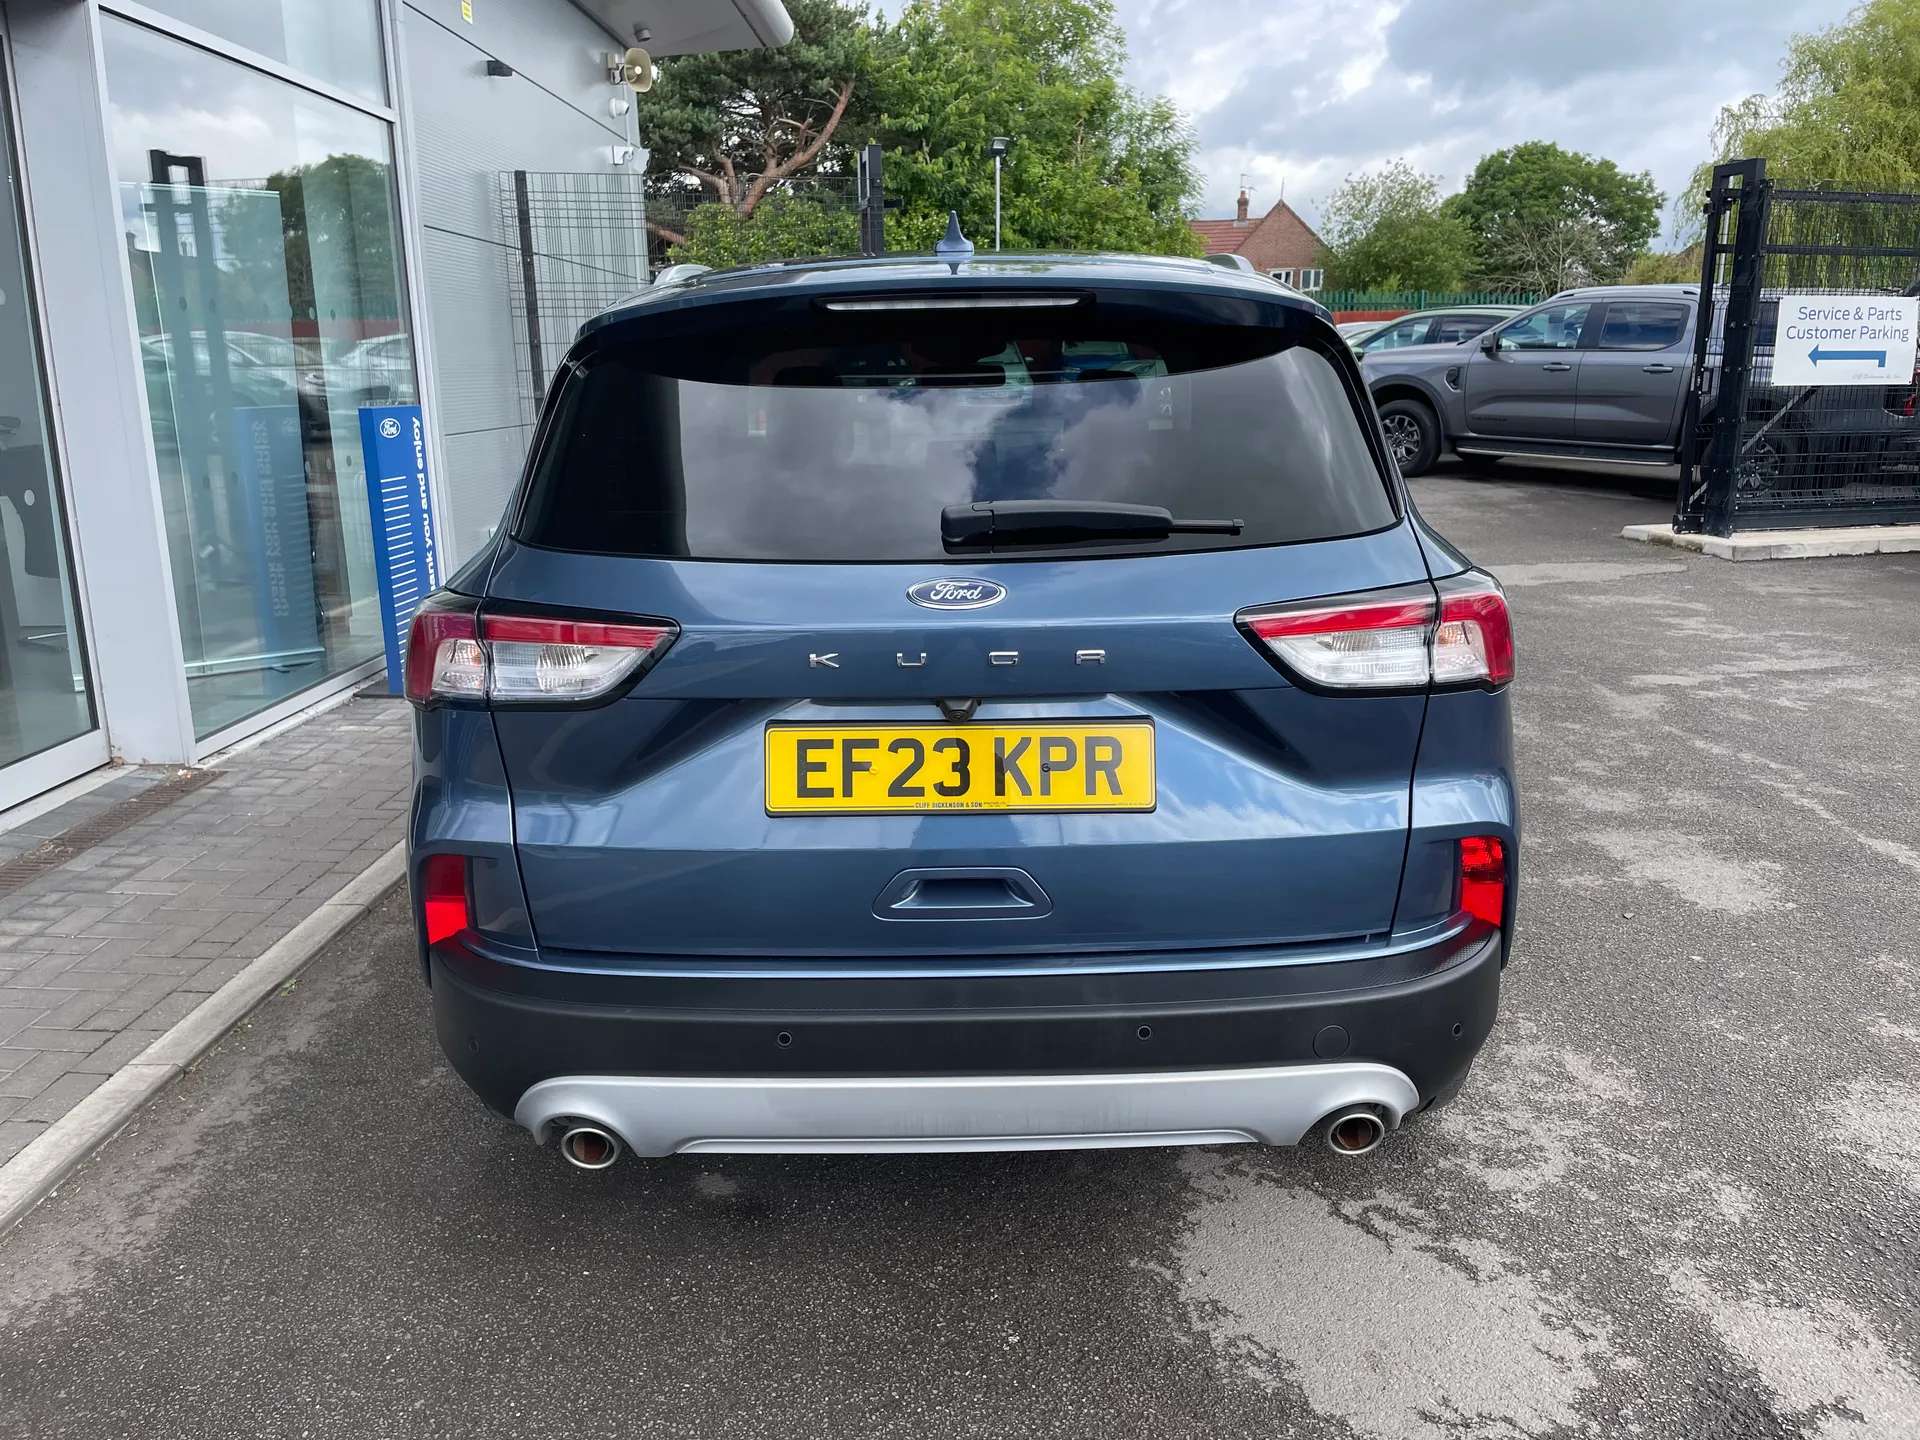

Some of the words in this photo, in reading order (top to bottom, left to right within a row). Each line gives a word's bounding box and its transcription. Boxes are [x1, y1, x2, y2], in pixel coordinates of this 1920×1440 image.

[1798, 306, 1850, 321] Service
[1853, 306, 1864, 321] &
[1867, 306, 1903, 321] Parts
[1786, 325, 1857, 340] Customer
[1860, 325, 1909, 342] Parking
[412, 416, 424, 470] enjoy
[416, 473, 428, 511] and
[422, 513, 433, 549] you
[930, 581, 982, 601] Ford
[809, 649, 1106, 668] KUGA
[796, 737, 970, 799] EF23
[994, 736, 1124, 797] KPR
